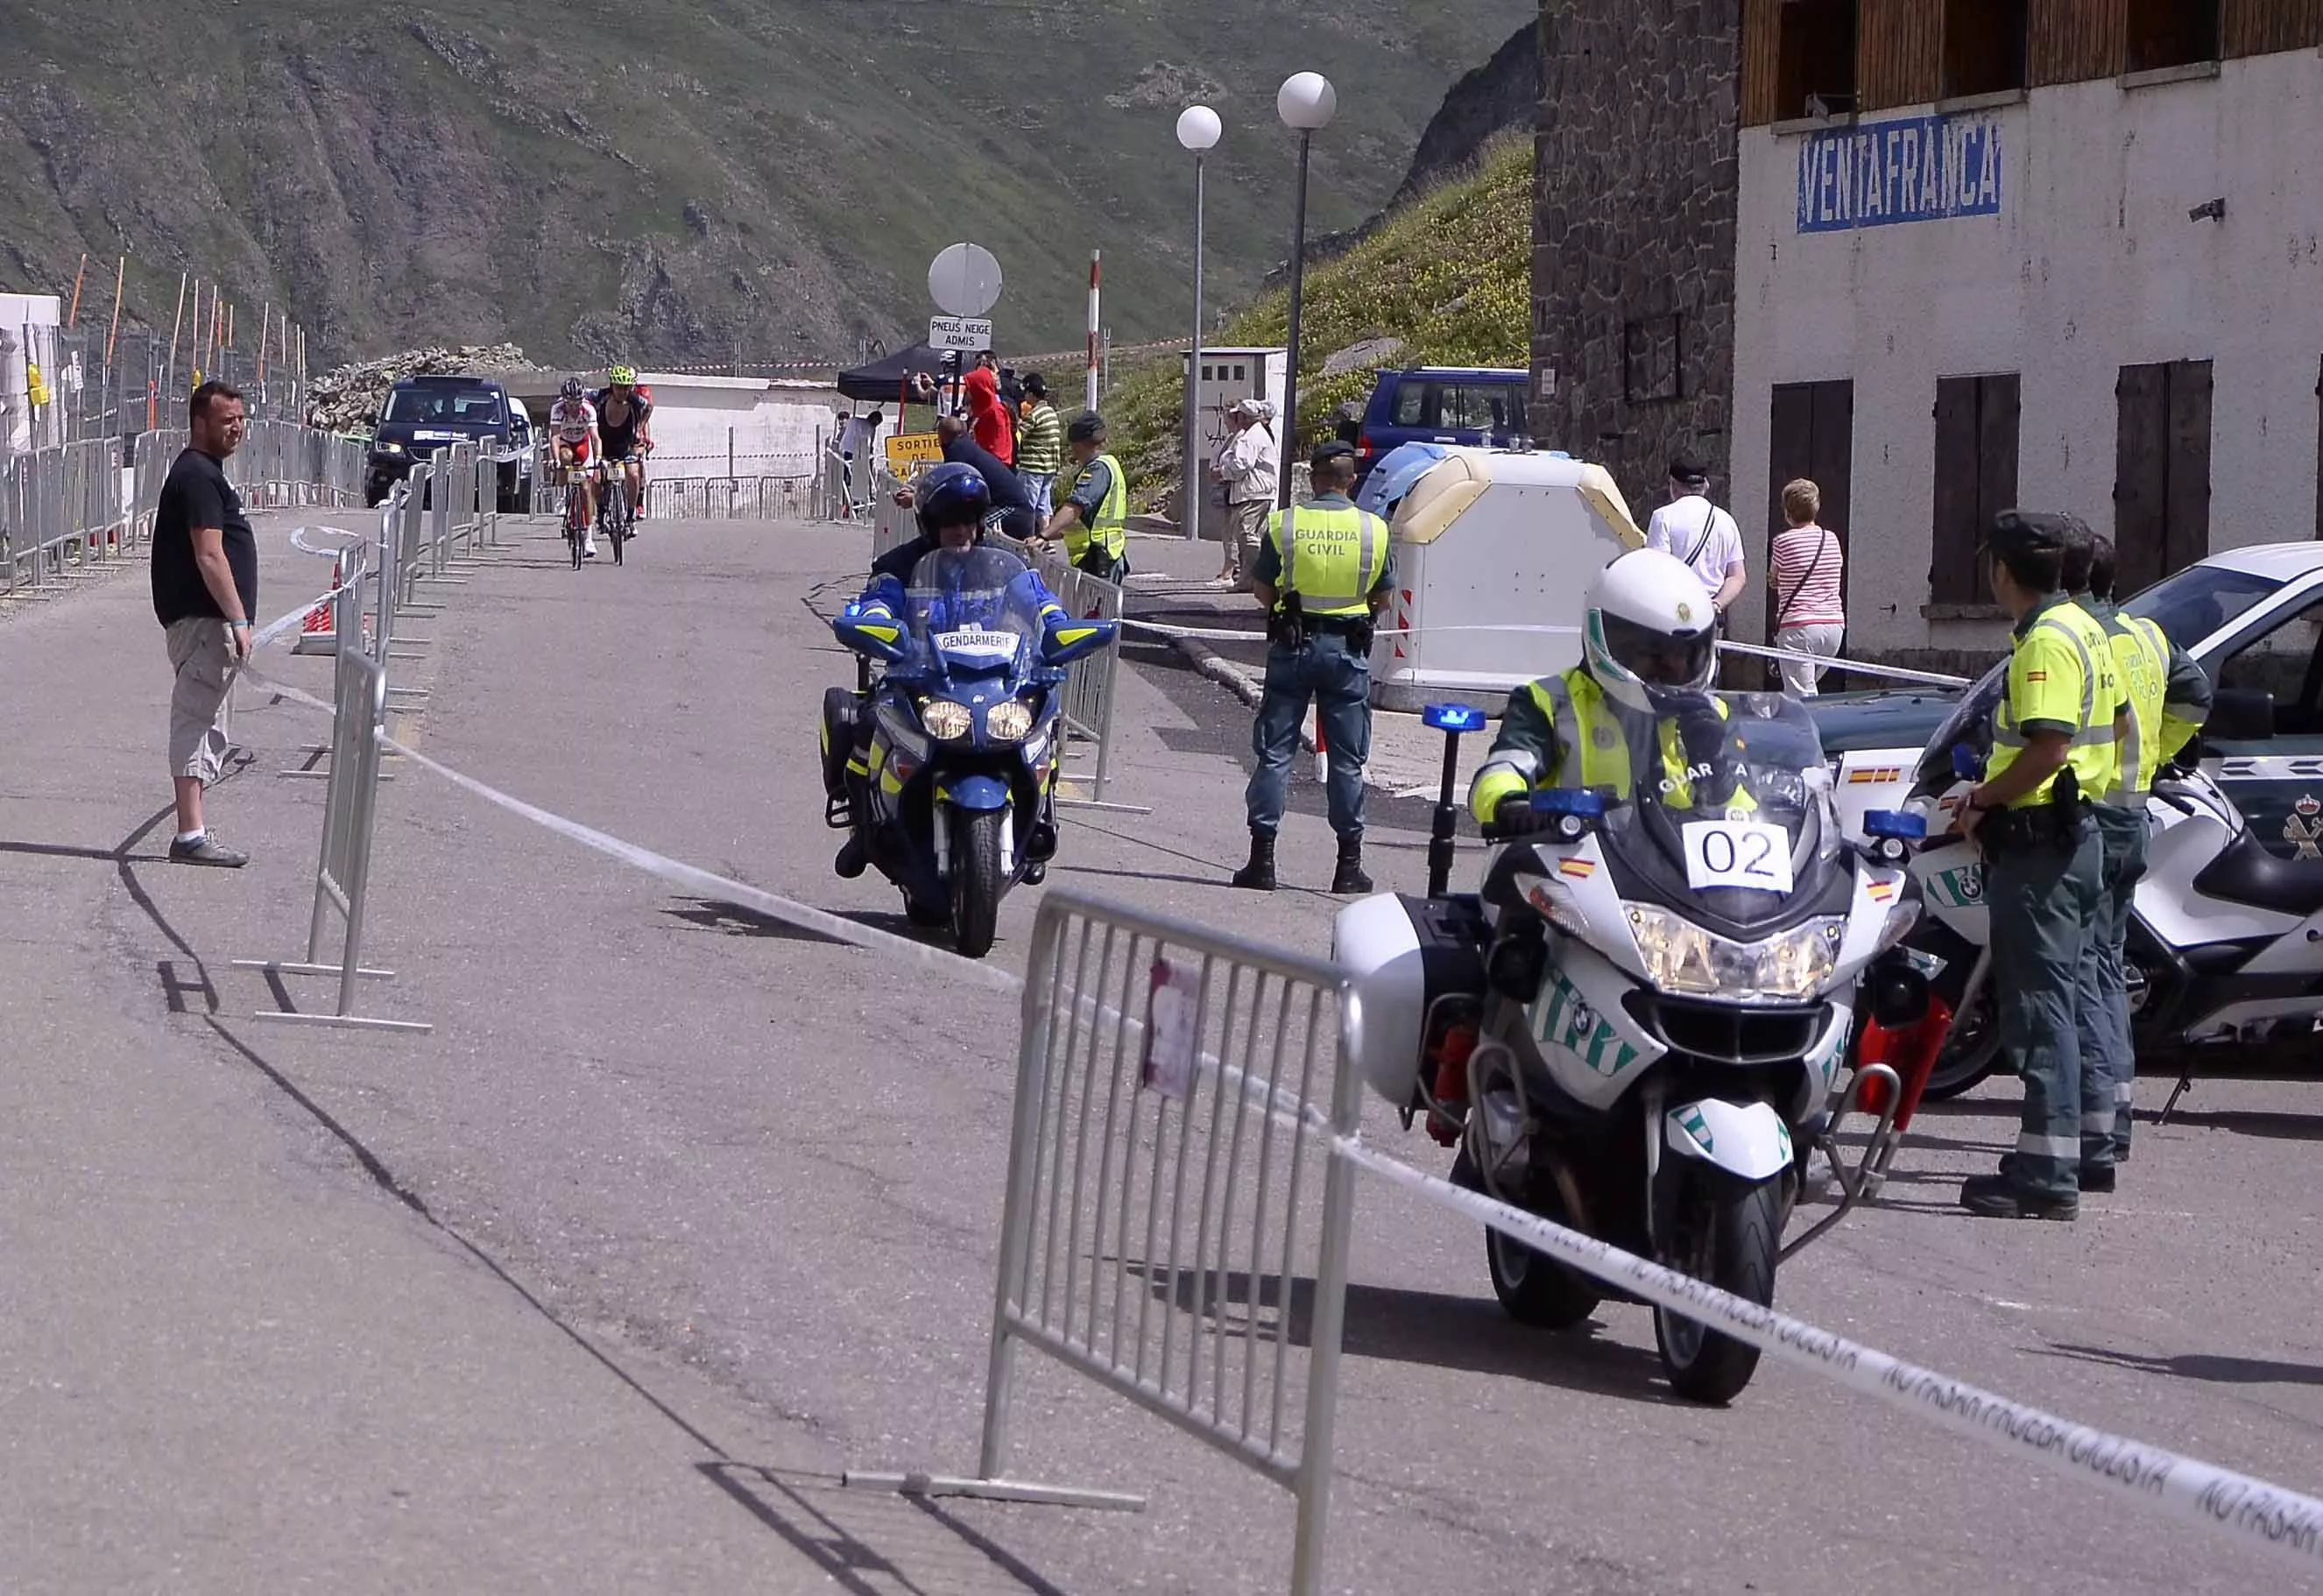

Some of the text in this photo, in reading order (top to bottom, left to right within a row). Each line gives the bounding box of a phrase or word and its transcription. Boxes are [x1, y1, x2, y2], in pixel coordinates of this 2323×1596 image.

[931, 321, 990, 335] PNEUS NEIGE
[945, 335, 975, 346] ADMIS
[897, 438, 940, 451] SORTIE
[1296, 528, 1359, 541] GUARDIA
[1307, 543, 1345, 555] CIVIL
[943, 634, 1010, 648] GENDARMERIE
[1702, 830, 1775, 877] 02
